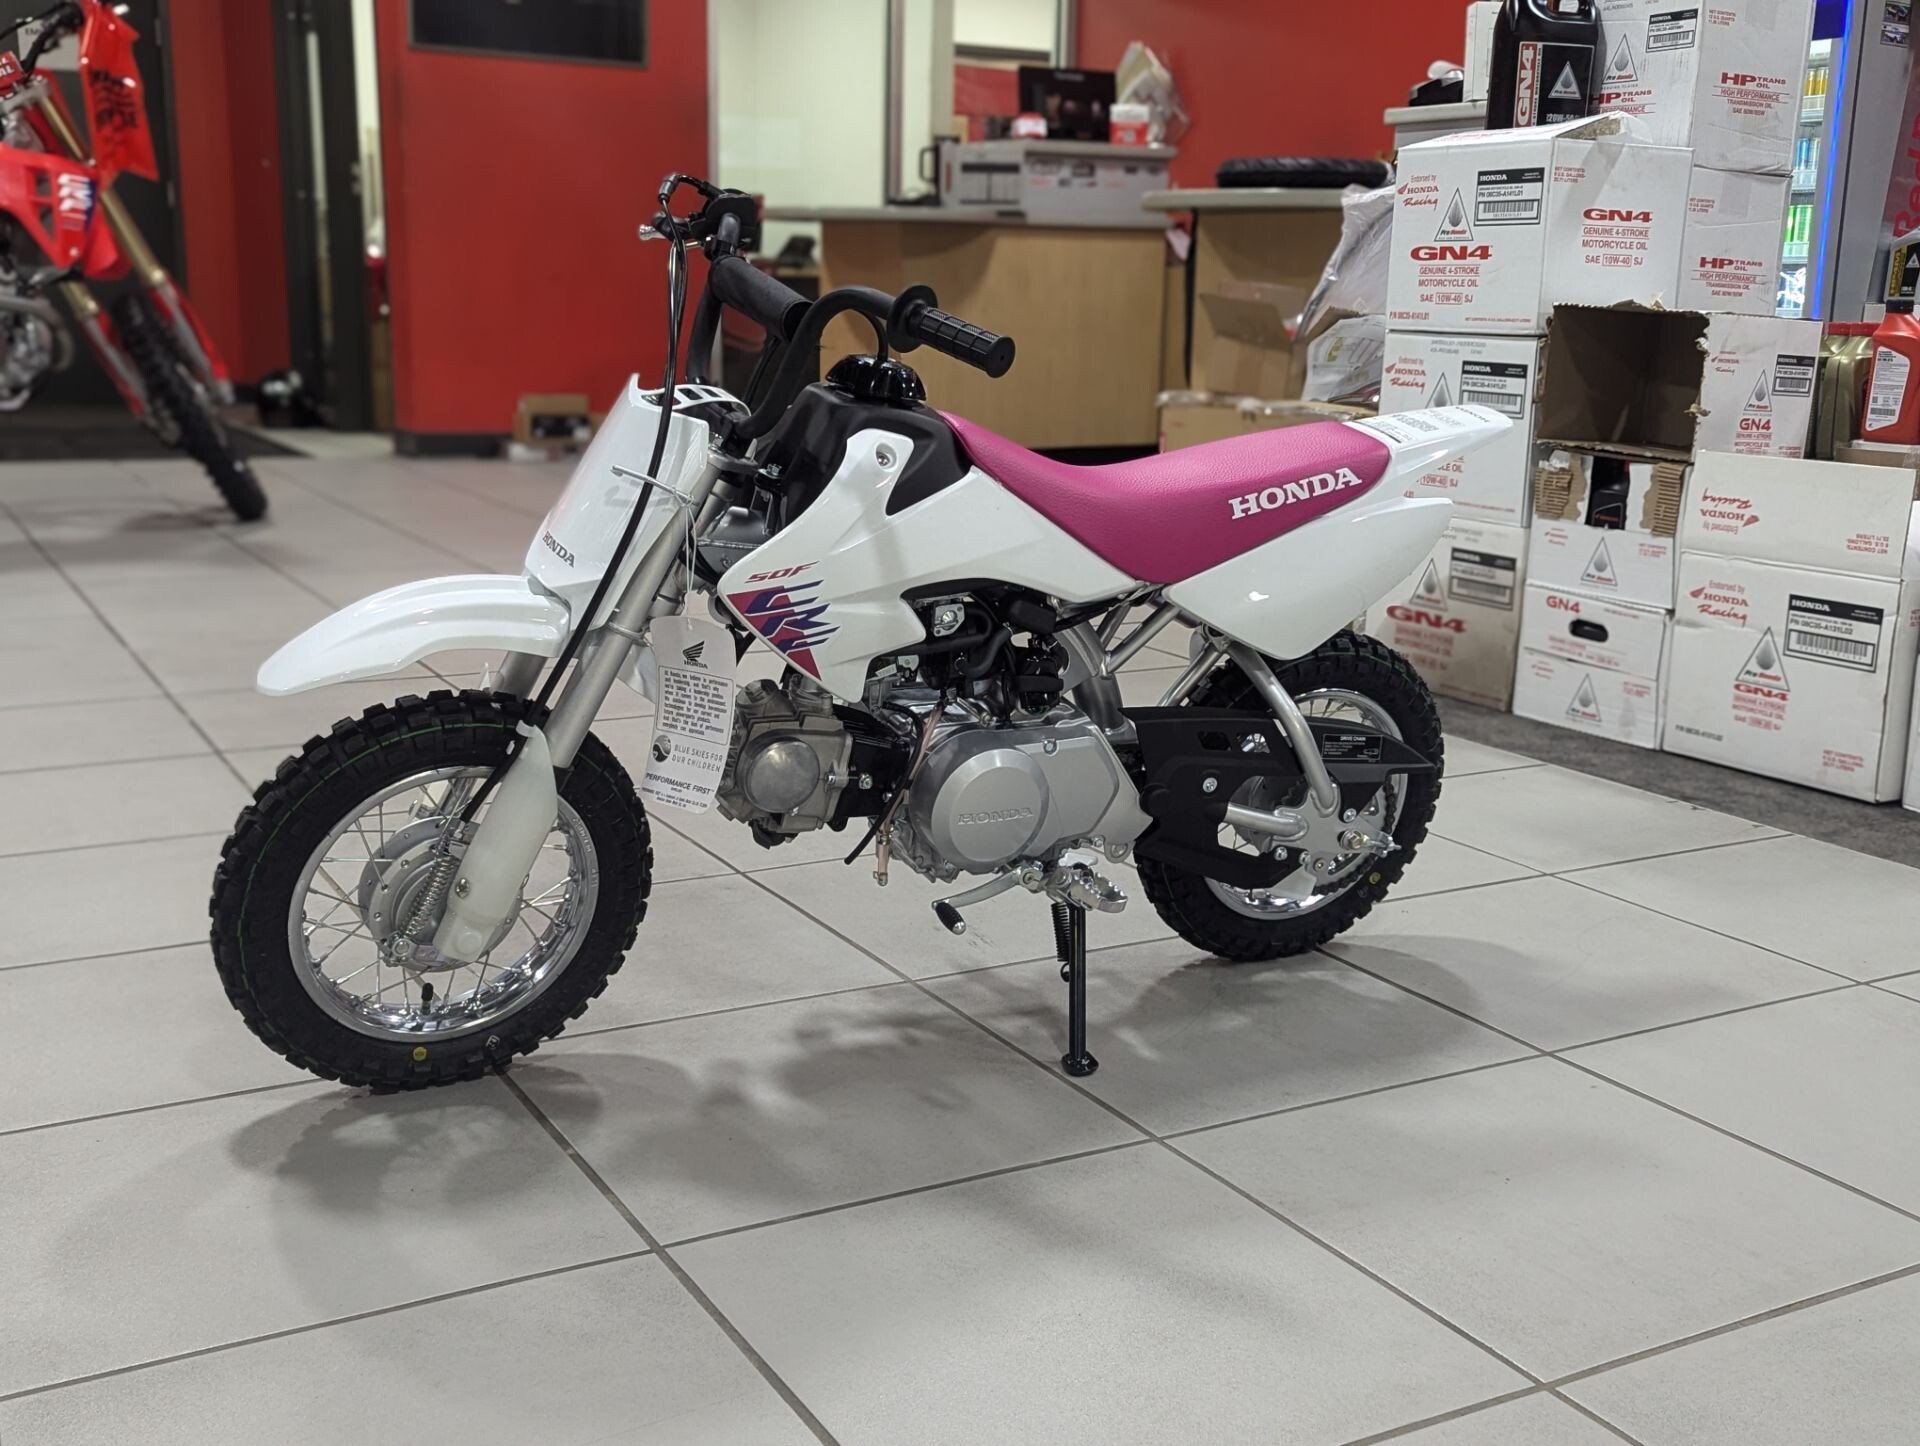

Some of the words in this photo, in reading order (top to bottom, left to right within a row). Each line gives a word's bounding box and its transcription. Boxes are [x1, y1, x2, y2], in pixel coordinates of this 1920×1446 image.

[1518, 46, 1534, 126] GN4
[1721, 72, 1756, 86] HP
[1721, 88, 1735, 96] HIGH
[1737, 90, 1780, 100] PERFORMANCE
[1728, 99, 1763, 107] TRANSMISSION
[1407, 186, 1439, 194] HONDA
[1403, 196, 1438, 211] Racing
[1583, 208, 1653, 222] GN4
[1584, 227, 1613, 235] GENUINE
[1615, 228, 1648, 237] 4-STROKE
[1582, 240, 1634, 249] MOTORCYCLE
[1636, 242, 1648, 250] OIL
[1411, 246, 1490, 261] GN4
[1585, 255, 1600, 263] SAE
[1604, 256, 1630, 264] 10W-40
[1634, 257, 1643, 265] SJ
[1700, 257, 1734, 269] HP
[1715, 274, 1756, 283] PERFORMANCE
[1395, 368, 1426, 376] HONDA
[1391, 377, 1425, 394] Racing
[1740, 418, 1771, 431] GN4
[1452, 464, 1463, 472] OIL
[1229, 467, 1362, 520] HONDA
[1702, 488, 1752, 508] Racing
[1700, 509, 1745, 521] HONDA
[542, 532, 574, 568] HONDA
[744, 561, 820, 583] 50F
[1709, 580, 1737, 591] Endorsed
[1738, 586, 1745, 594] by
[1546, 595, 1580, 614] GN4
[1703, 593, 1749, 607] HONDA
[1792, 599, 1830, 612] HONDA
[1386, 605, 1466, 633] GN4
[1697, 604, 1747, 627] Racing
[684, 660, 708, 668] HONDA
[1734, 683, 1789, 701] GN4
[1732, 704, 1773, 718] MOTORCYCLE
[675, 744, 690, 754] BLUE
[692, 748, 709, 759] SKIES
[711, 753, 722, 763] FOR
[672, 754, 685, 764] OUR
[687, 759, 720, 772] CHILDREN
[646, 772, 691, 790] PERFORMANCE
[958, 808, 1034, 824] HONDA
